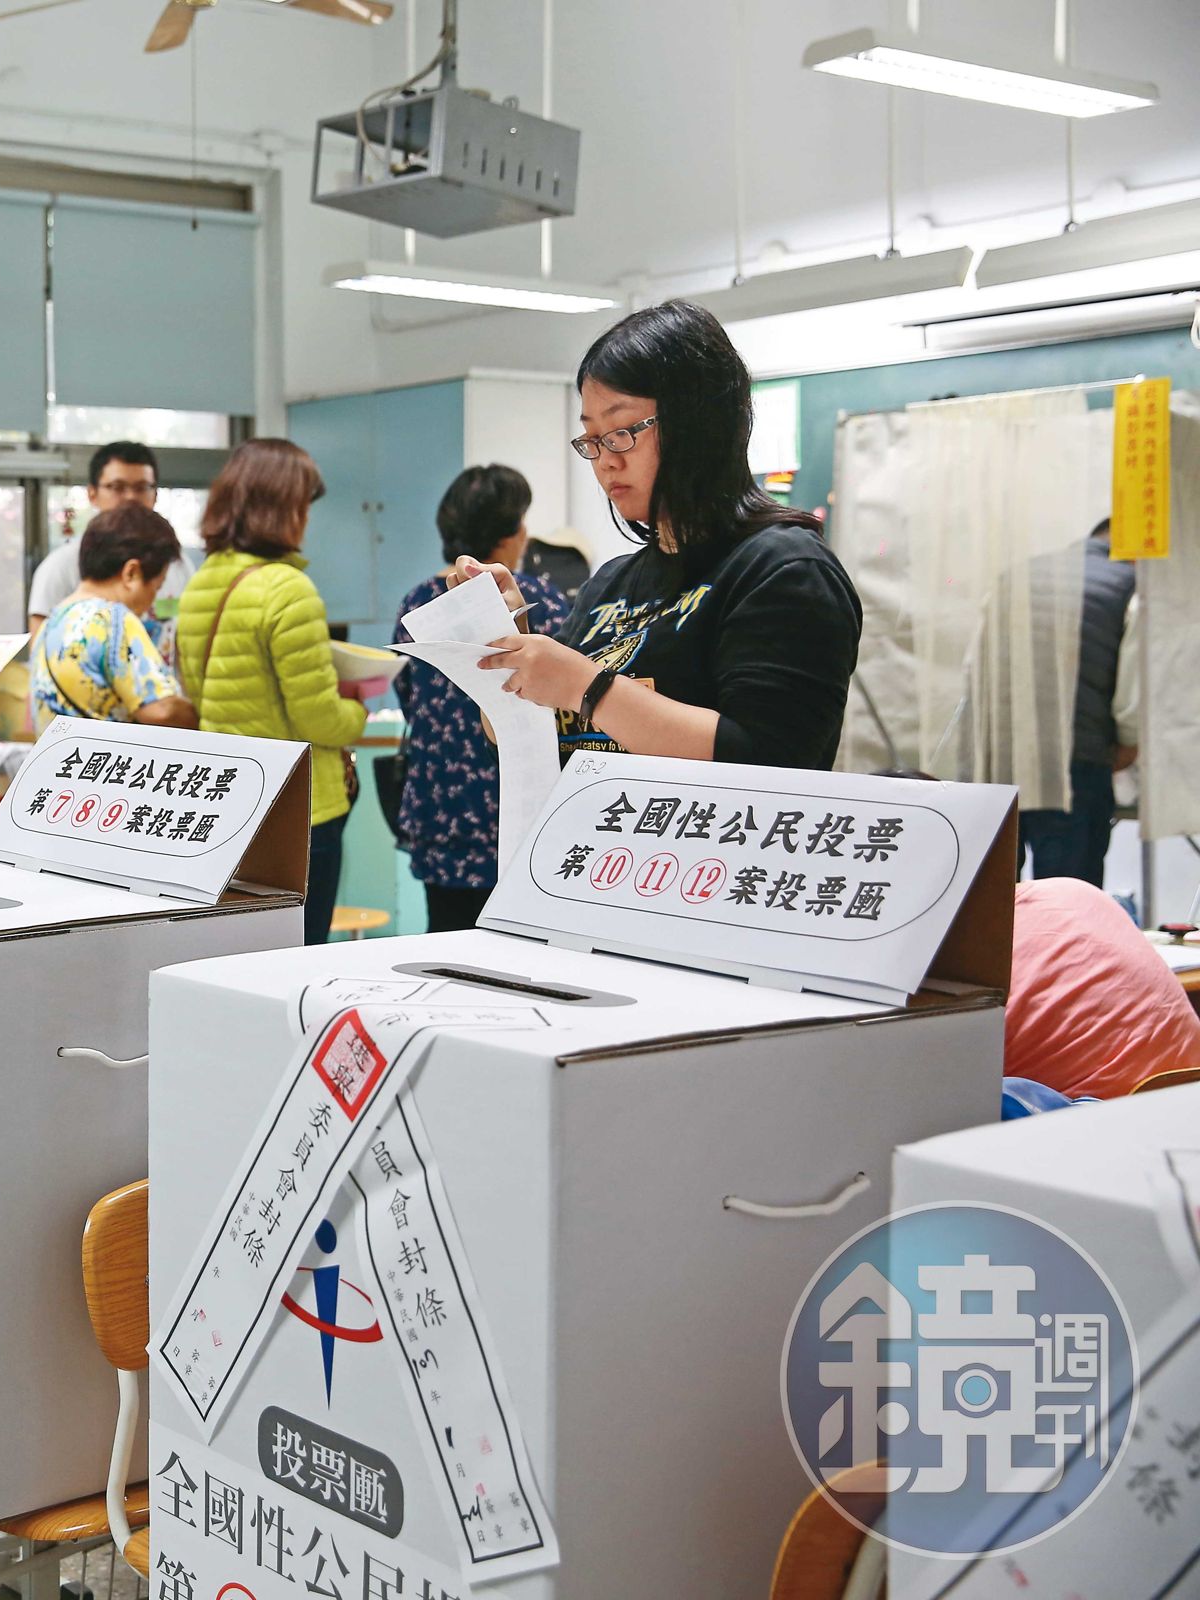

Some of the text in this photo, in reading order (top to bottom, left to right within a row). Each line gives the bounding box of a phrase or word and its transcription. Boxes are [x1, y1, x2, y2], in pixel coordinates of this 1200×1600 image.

[54, 746, 239, 803] 全國性公民投票
[595, 791, 904, 864] 全國性公民投票
[271, 1420, 389, 1526] 投票匭
[155, 1450, 464, 1600] 全國性公民
